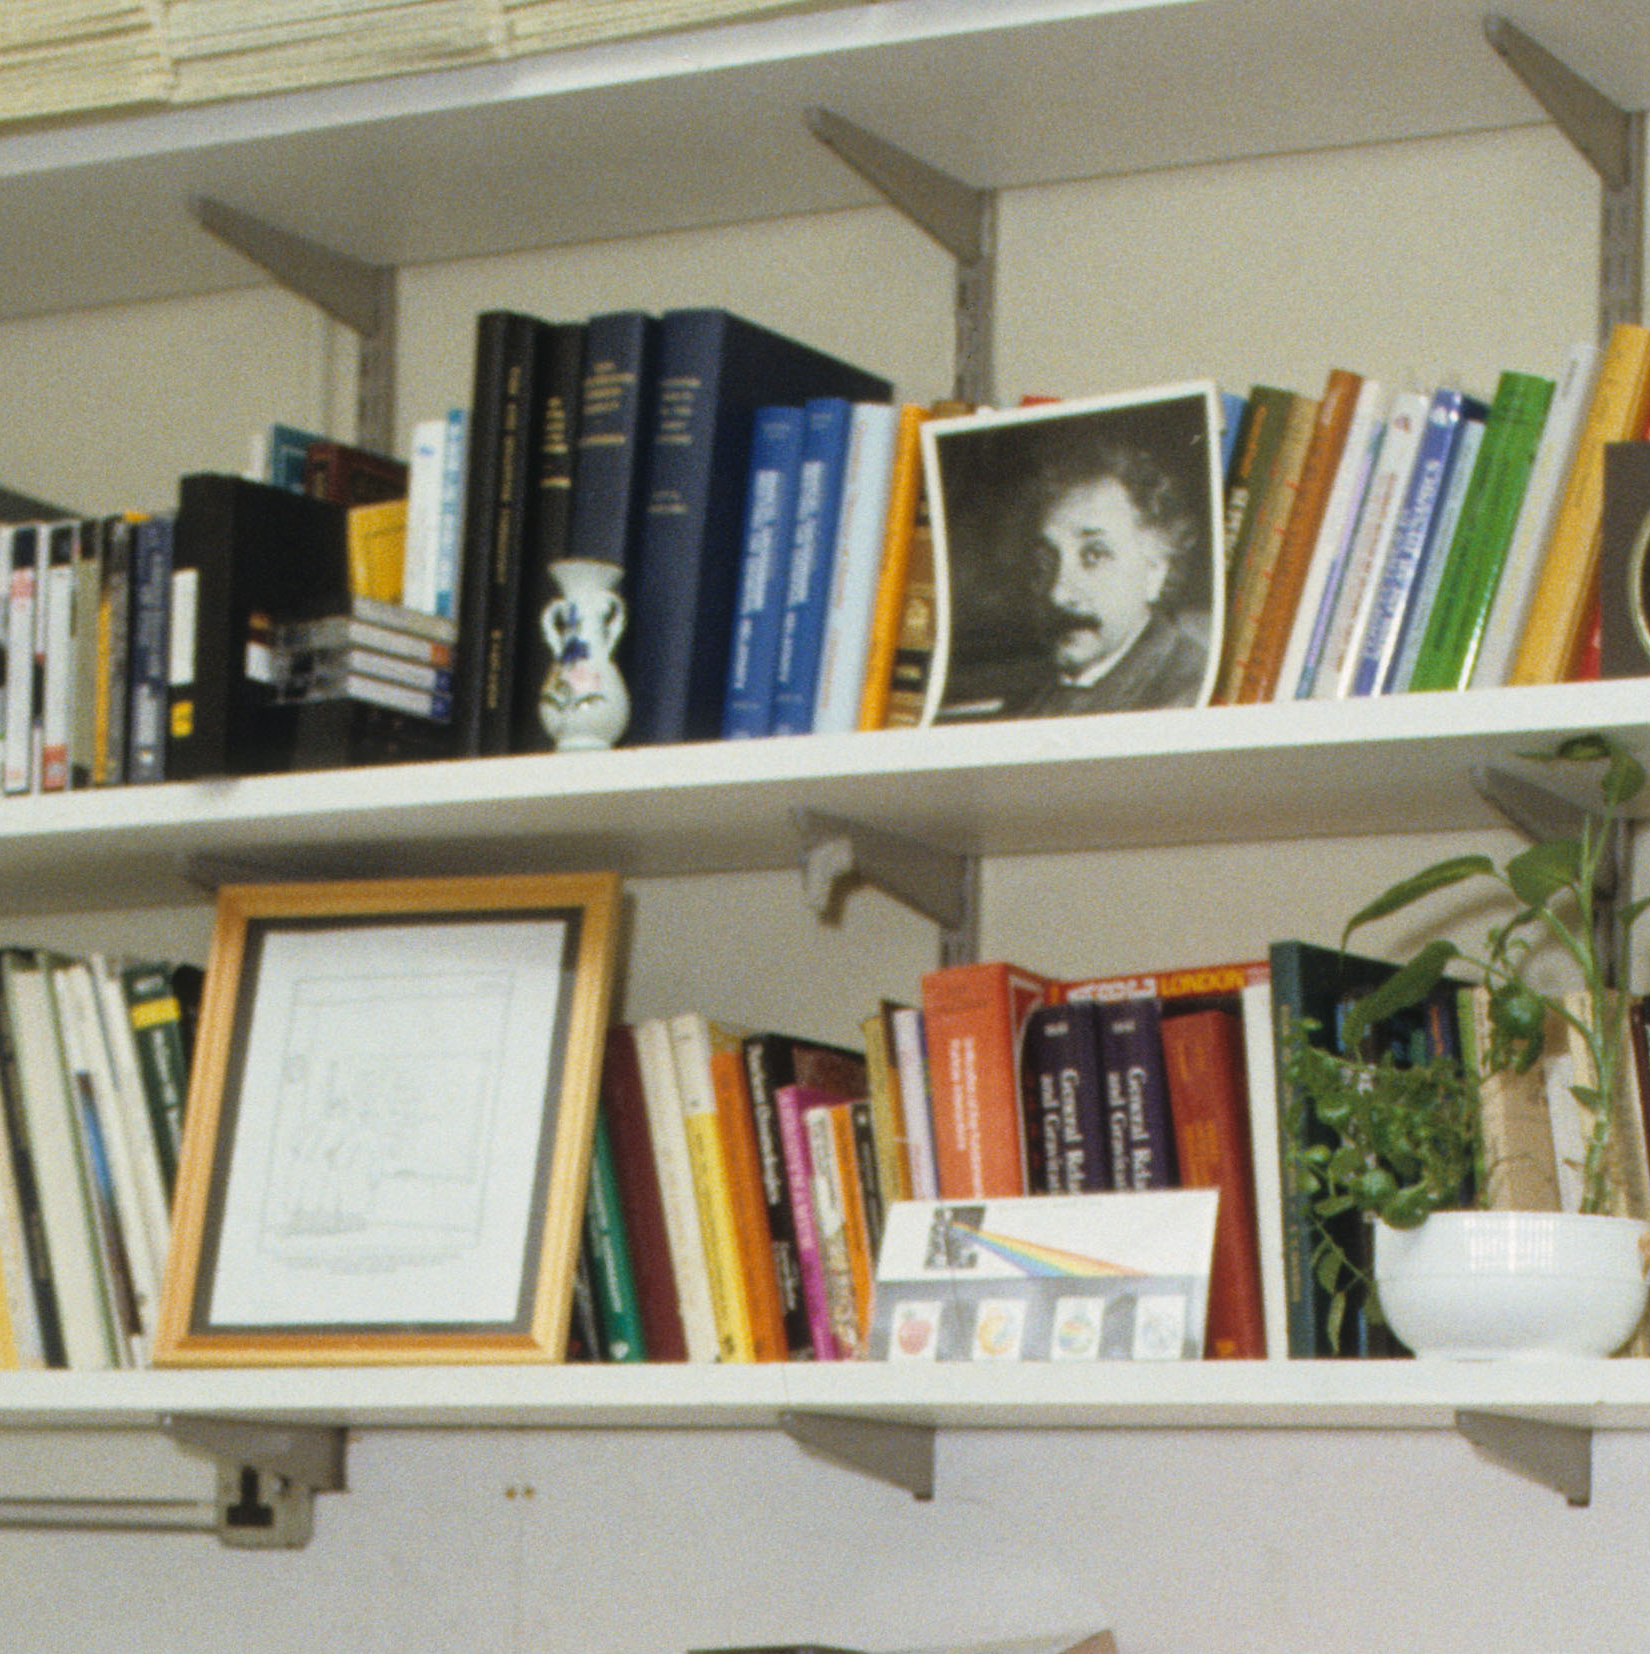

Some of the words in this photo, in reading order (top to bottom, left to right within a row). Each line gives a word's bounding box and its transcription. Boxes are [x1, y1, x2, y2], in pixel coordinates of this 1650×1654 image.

[1040, 1074, 1060, 1108] and
[1059, 1067, 1086, 1142] General
[1107, 1071, 1127, 1106] and
[1126, 1066, 1152, 1140] General
